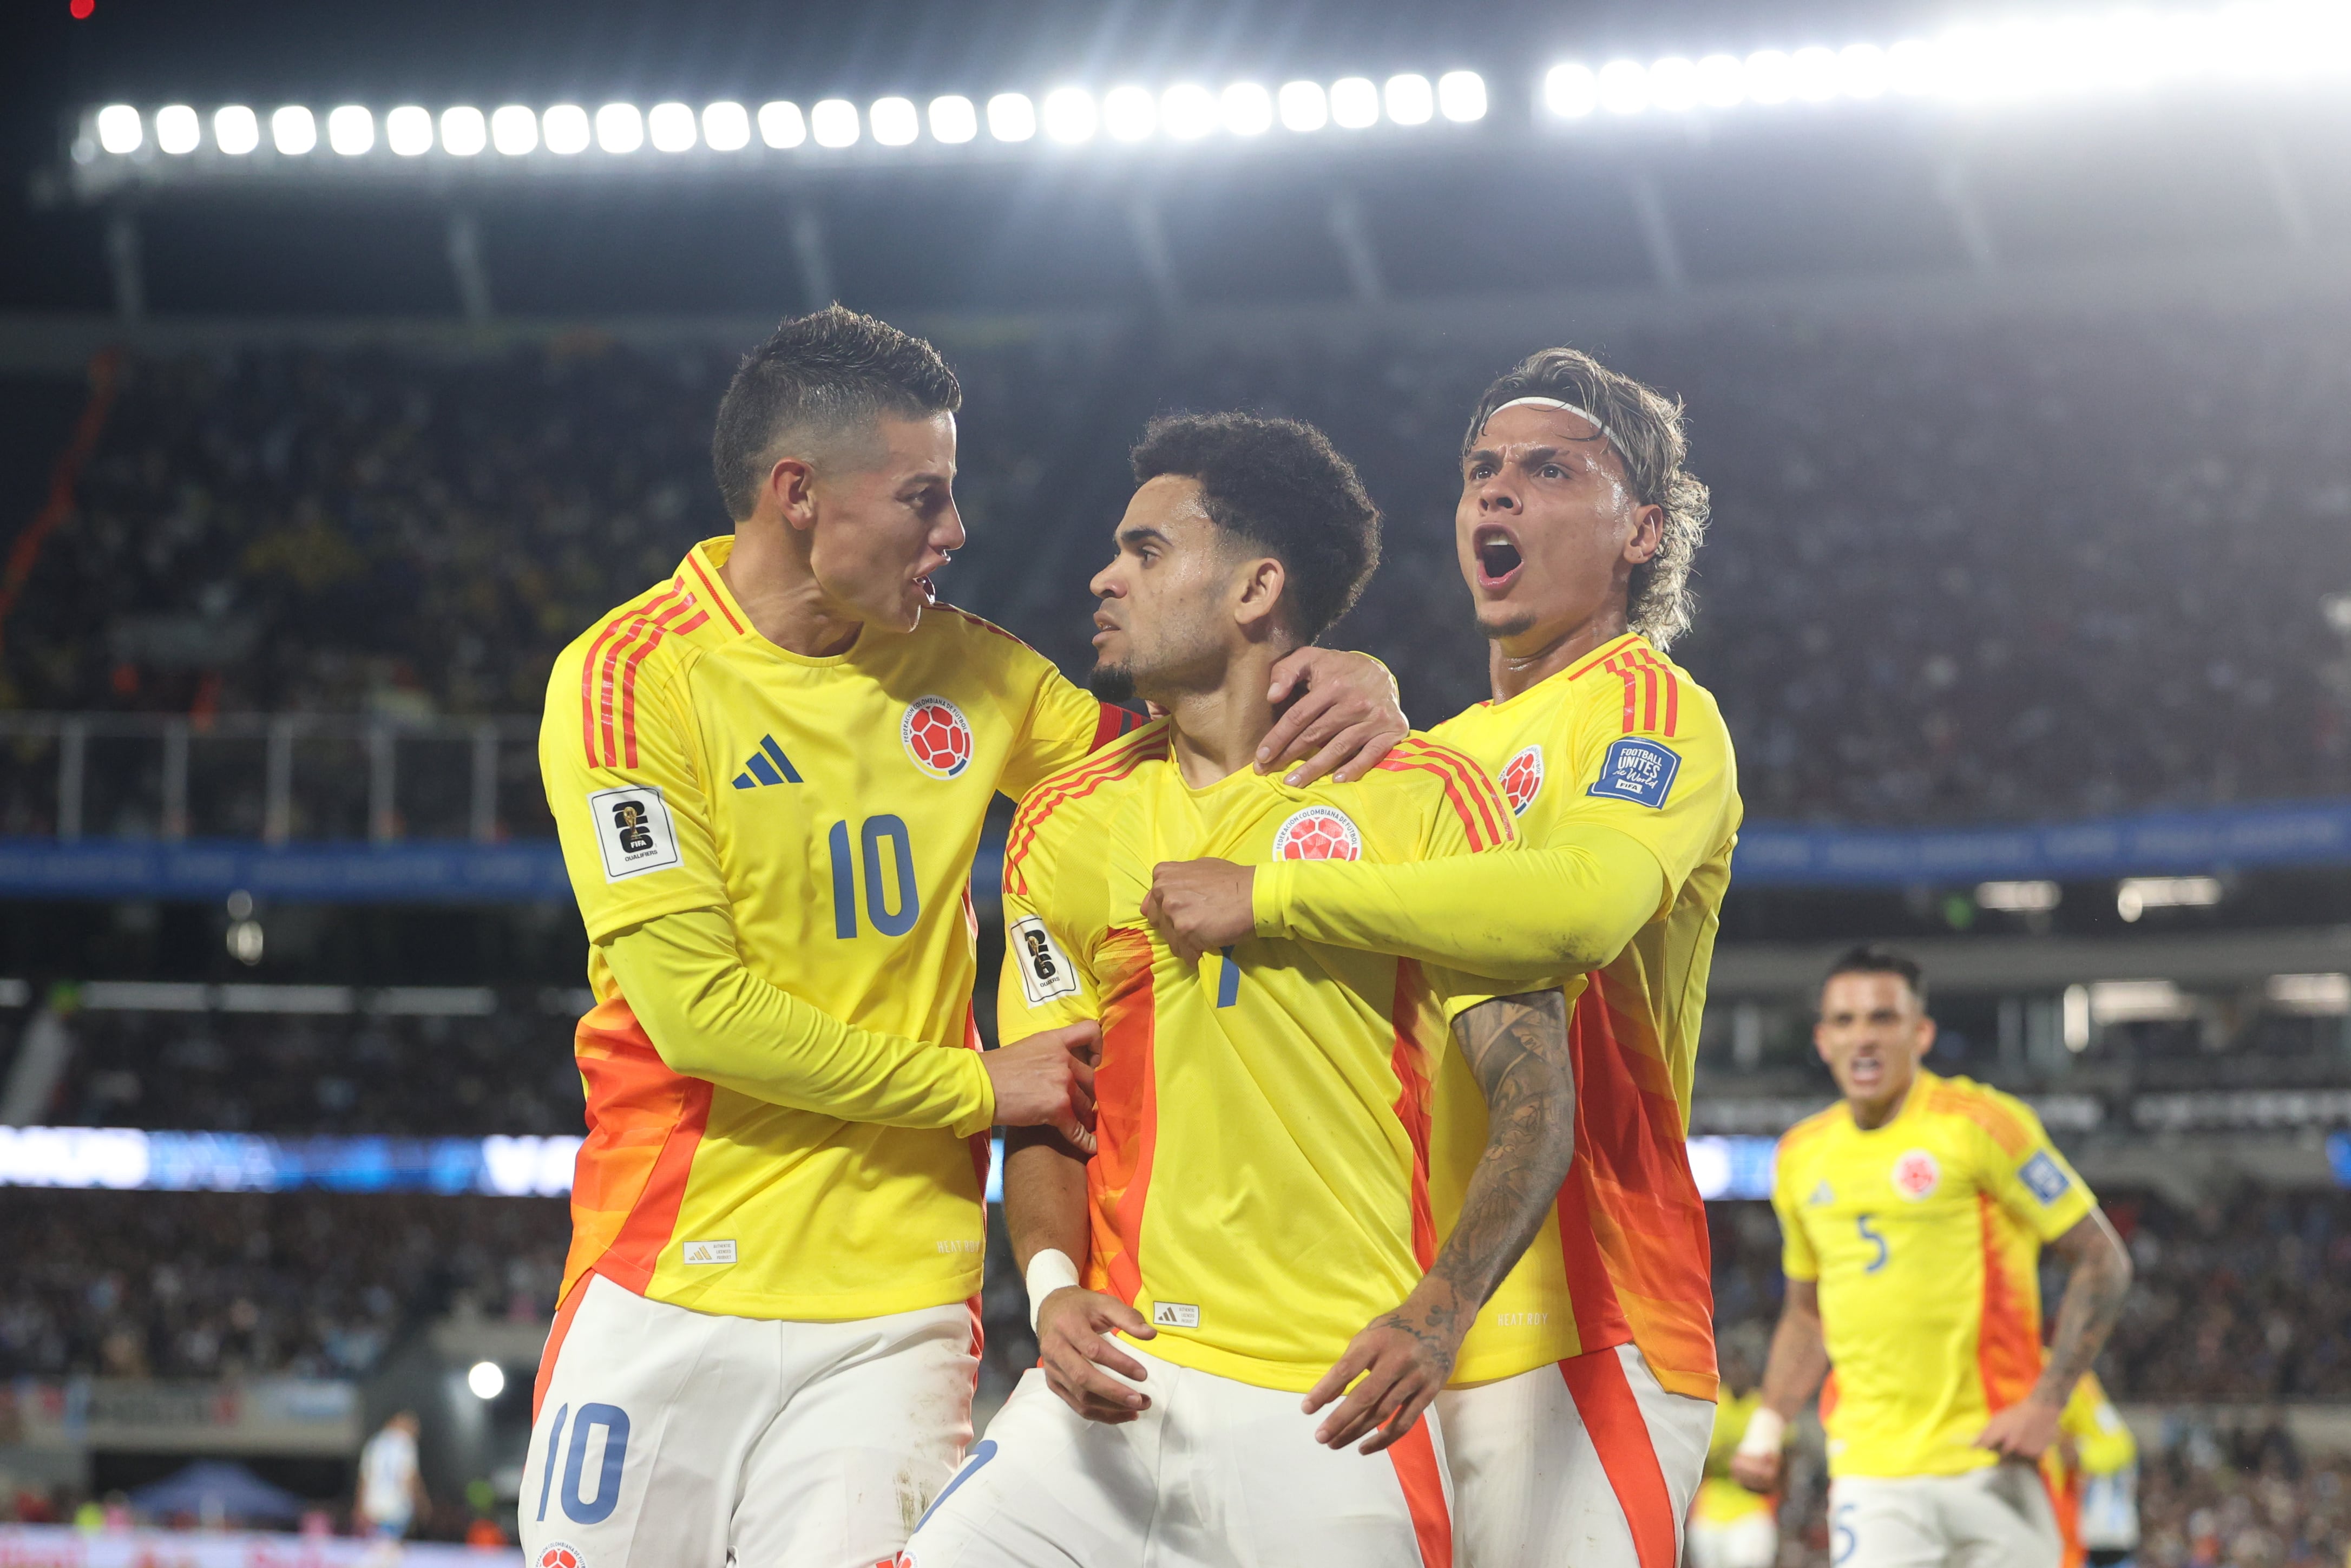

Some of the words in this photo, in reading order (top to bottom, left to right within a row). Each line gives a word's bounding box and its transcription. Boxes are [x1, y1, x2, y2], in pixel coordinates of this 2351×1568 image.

[913, 698, 945, 710] COLOMBIANA
[946, 703, 953, 711] DE
[1620, 748, 1662, 766] FOOTBALL
[1618, 756, 1660, 779] UNITES
[1626, 767, 1659, 789] World
[1299, 809, 1339, 819] COLOMBIANA
[1338, 816, 1347, 824] DE
[630, 839, 647, 849] FIFA
[625, 849, 658, 862] QUALIFIERS
[829, 814, 920, 939] 10
[1857, 1212, 1889, 1274] 5
[536, 1402, 631, 1525] 10
